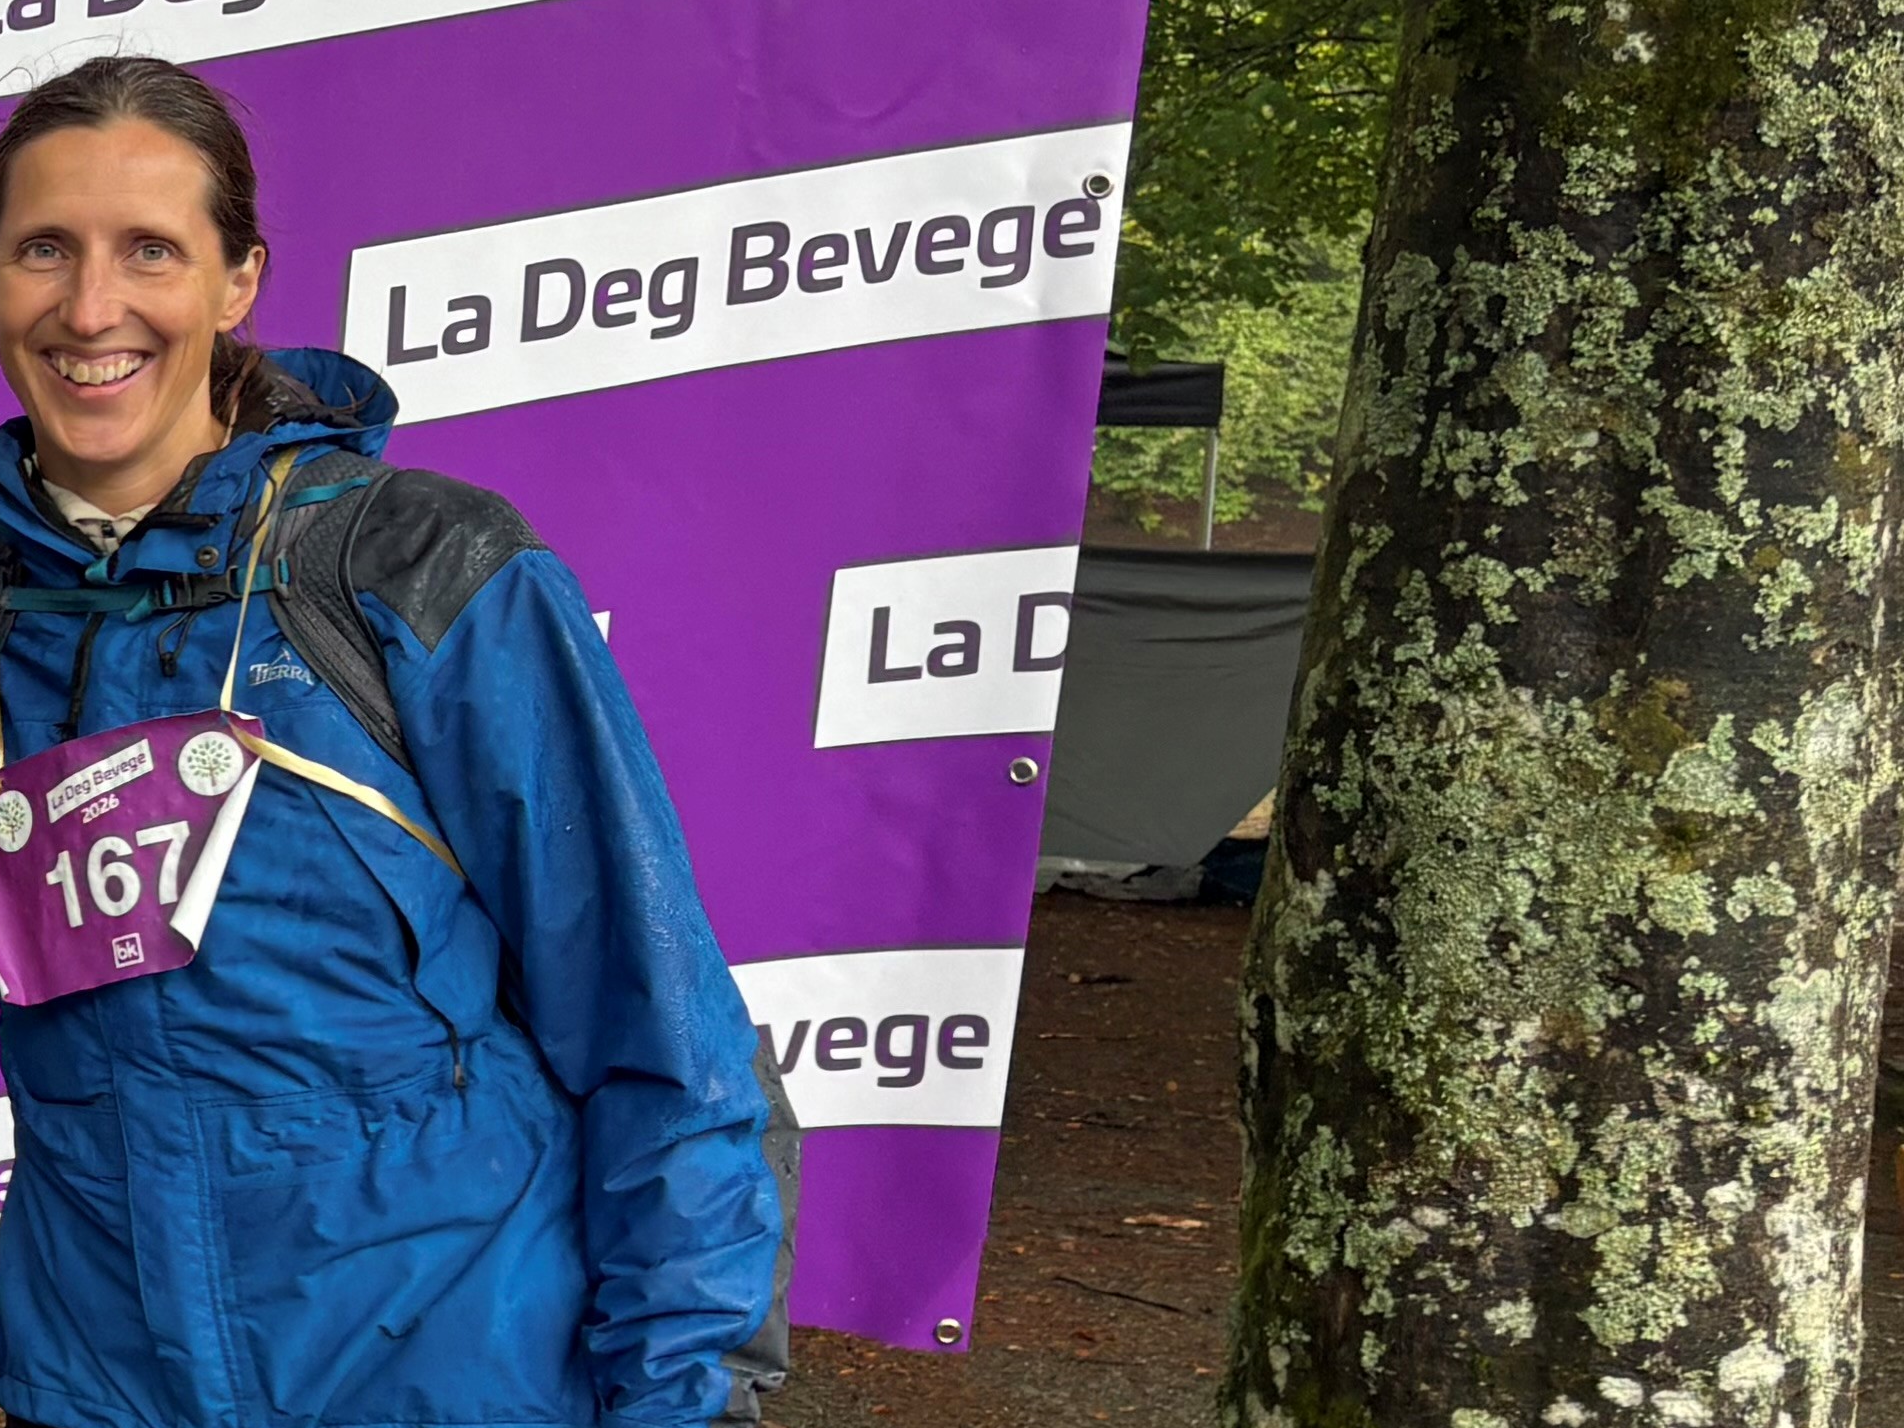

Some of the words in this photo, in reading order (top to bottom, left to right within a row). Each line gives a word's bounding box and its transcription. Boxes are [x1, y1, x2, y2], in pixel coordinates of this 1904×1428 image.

[387, 286, 491, 366] La
[521, 257, 698, 342] Deg
[727, 197, 1101, 305] Bevege
[868, 607, 981, 684] La
[80, 793, 120, 824] 2026
[46, 821, 190, 927] 167
